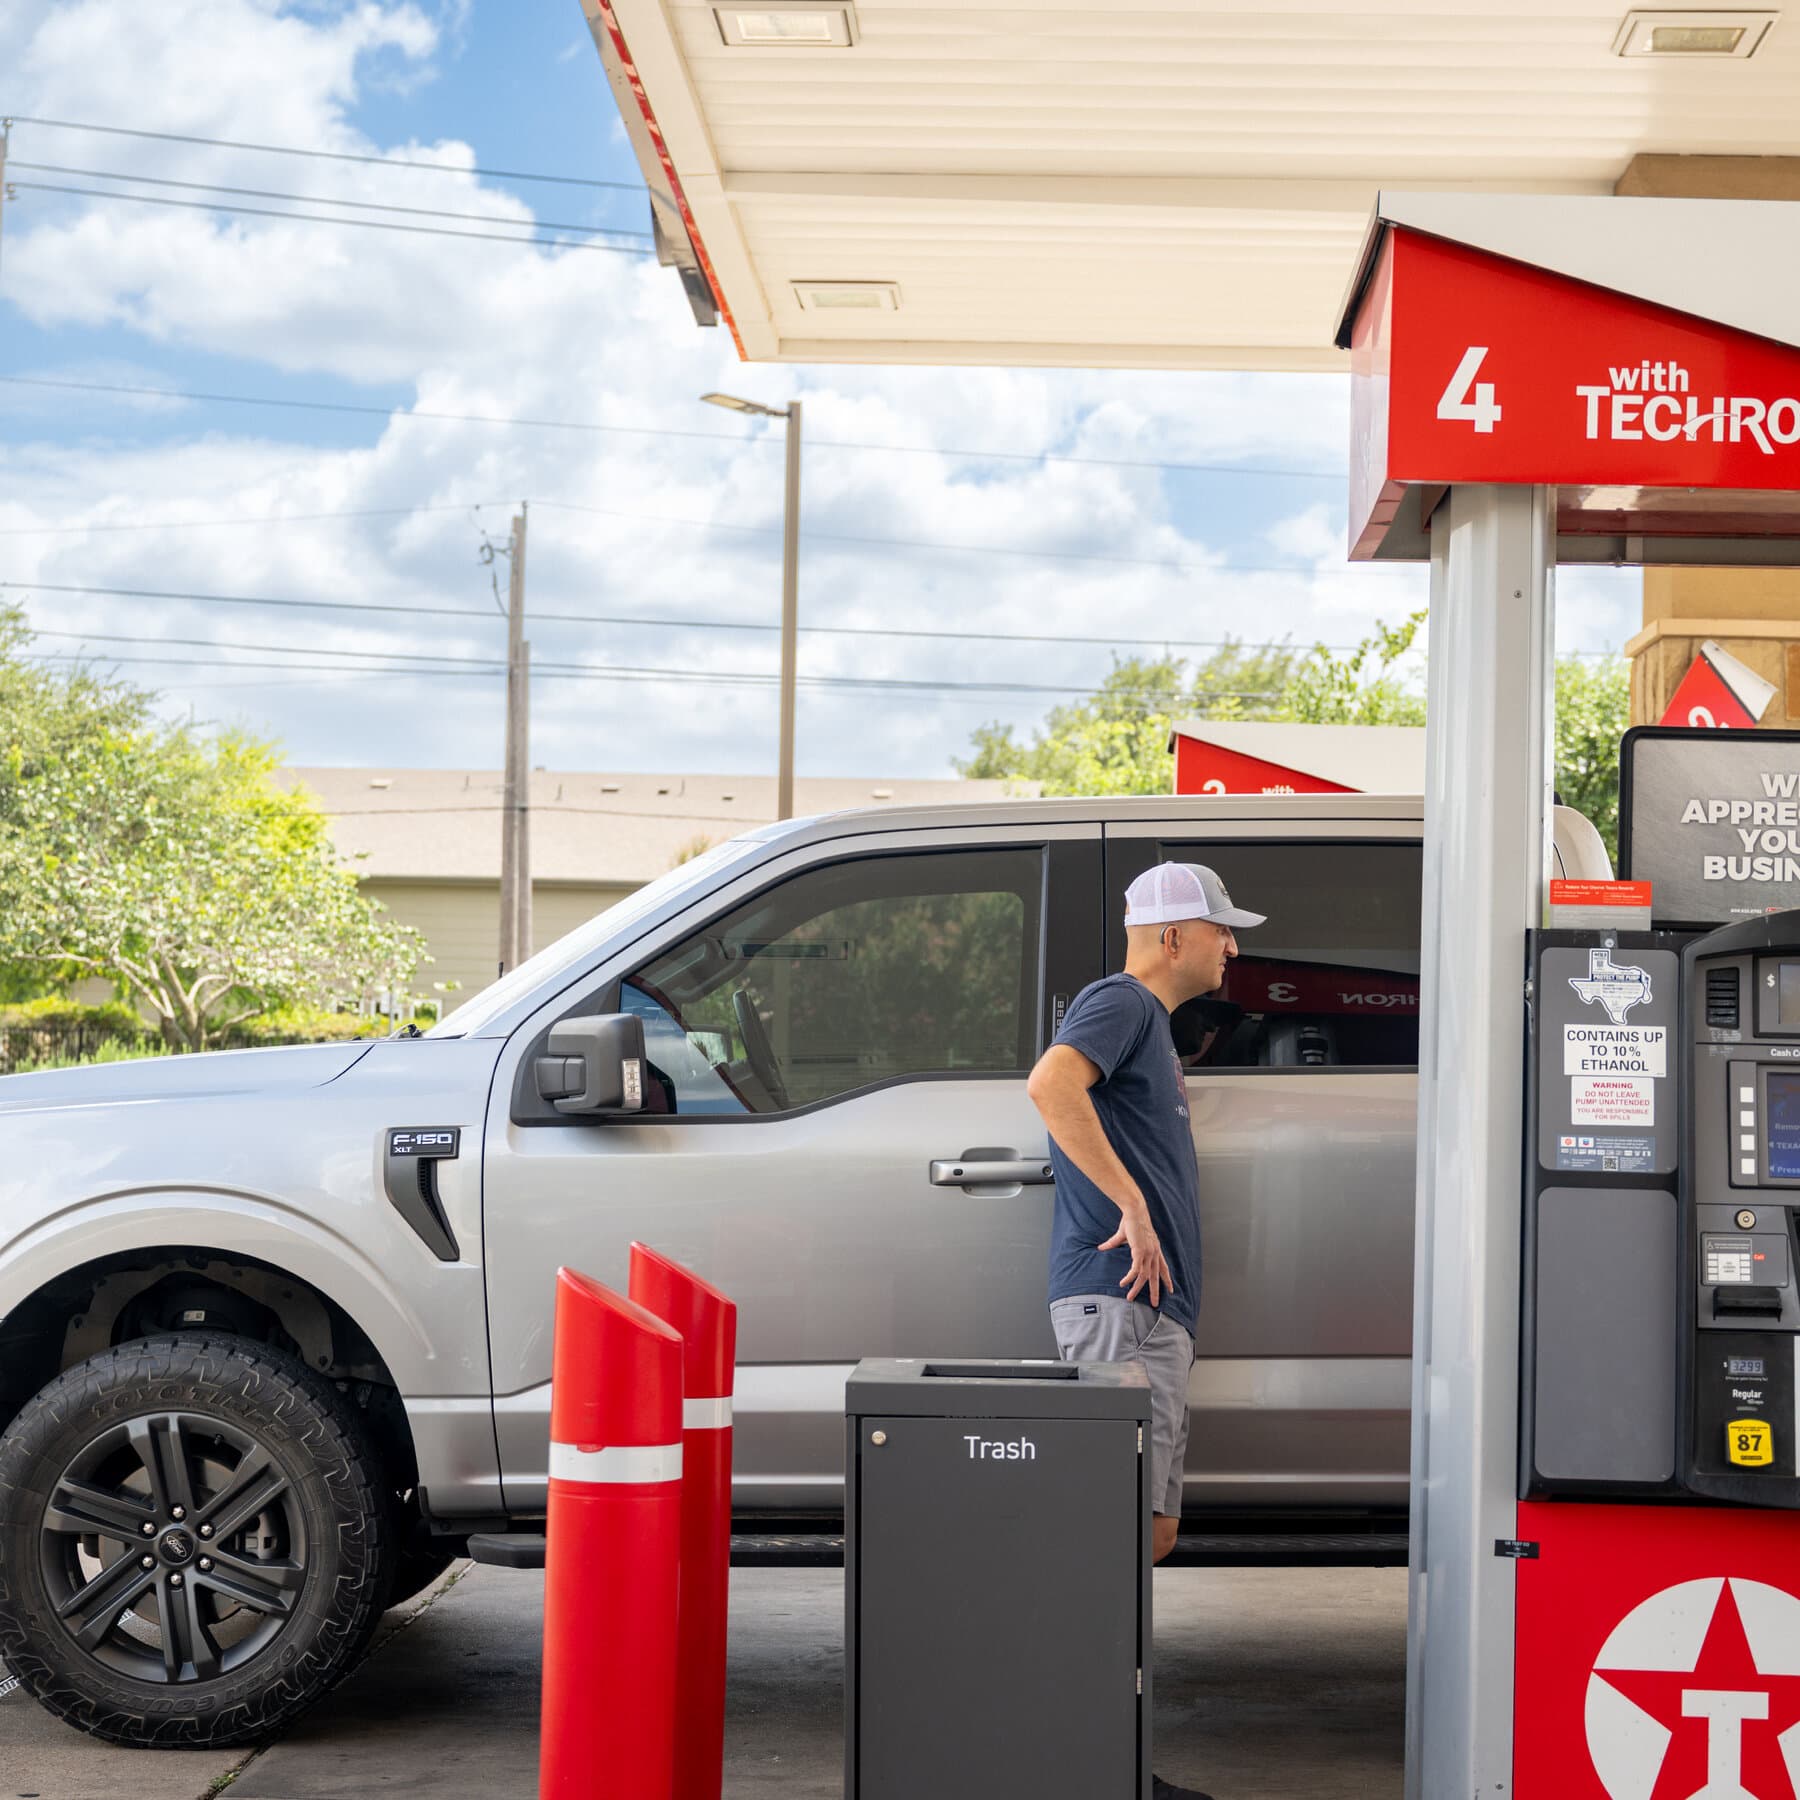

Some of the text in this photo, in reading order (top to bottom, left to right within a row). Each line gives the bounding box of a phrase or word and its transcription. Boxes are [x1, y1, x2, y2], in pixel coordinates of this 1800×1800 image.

[1608, 360, 1689, 392] with
[1436, 346, 1502, 433] 4
[1760, 773, 1800, 798] W
[1680, 799, 1800, 826] APPRE
[1567, 1030, 1663, 1043] CONTAINS UP
[1589, 1045, 1608, 1056] TO
[1770, 1048, 1792, 1057] Cash
[1581, 1059, 1649, 1072] ETHANOL
[393, 1133, 453, 1145] F-150
[1732, 1388, 1762, 1400] Regular
[963, 1435, 1036, 1459] Trash
[1737, 1434, 1762, 1452] 87
